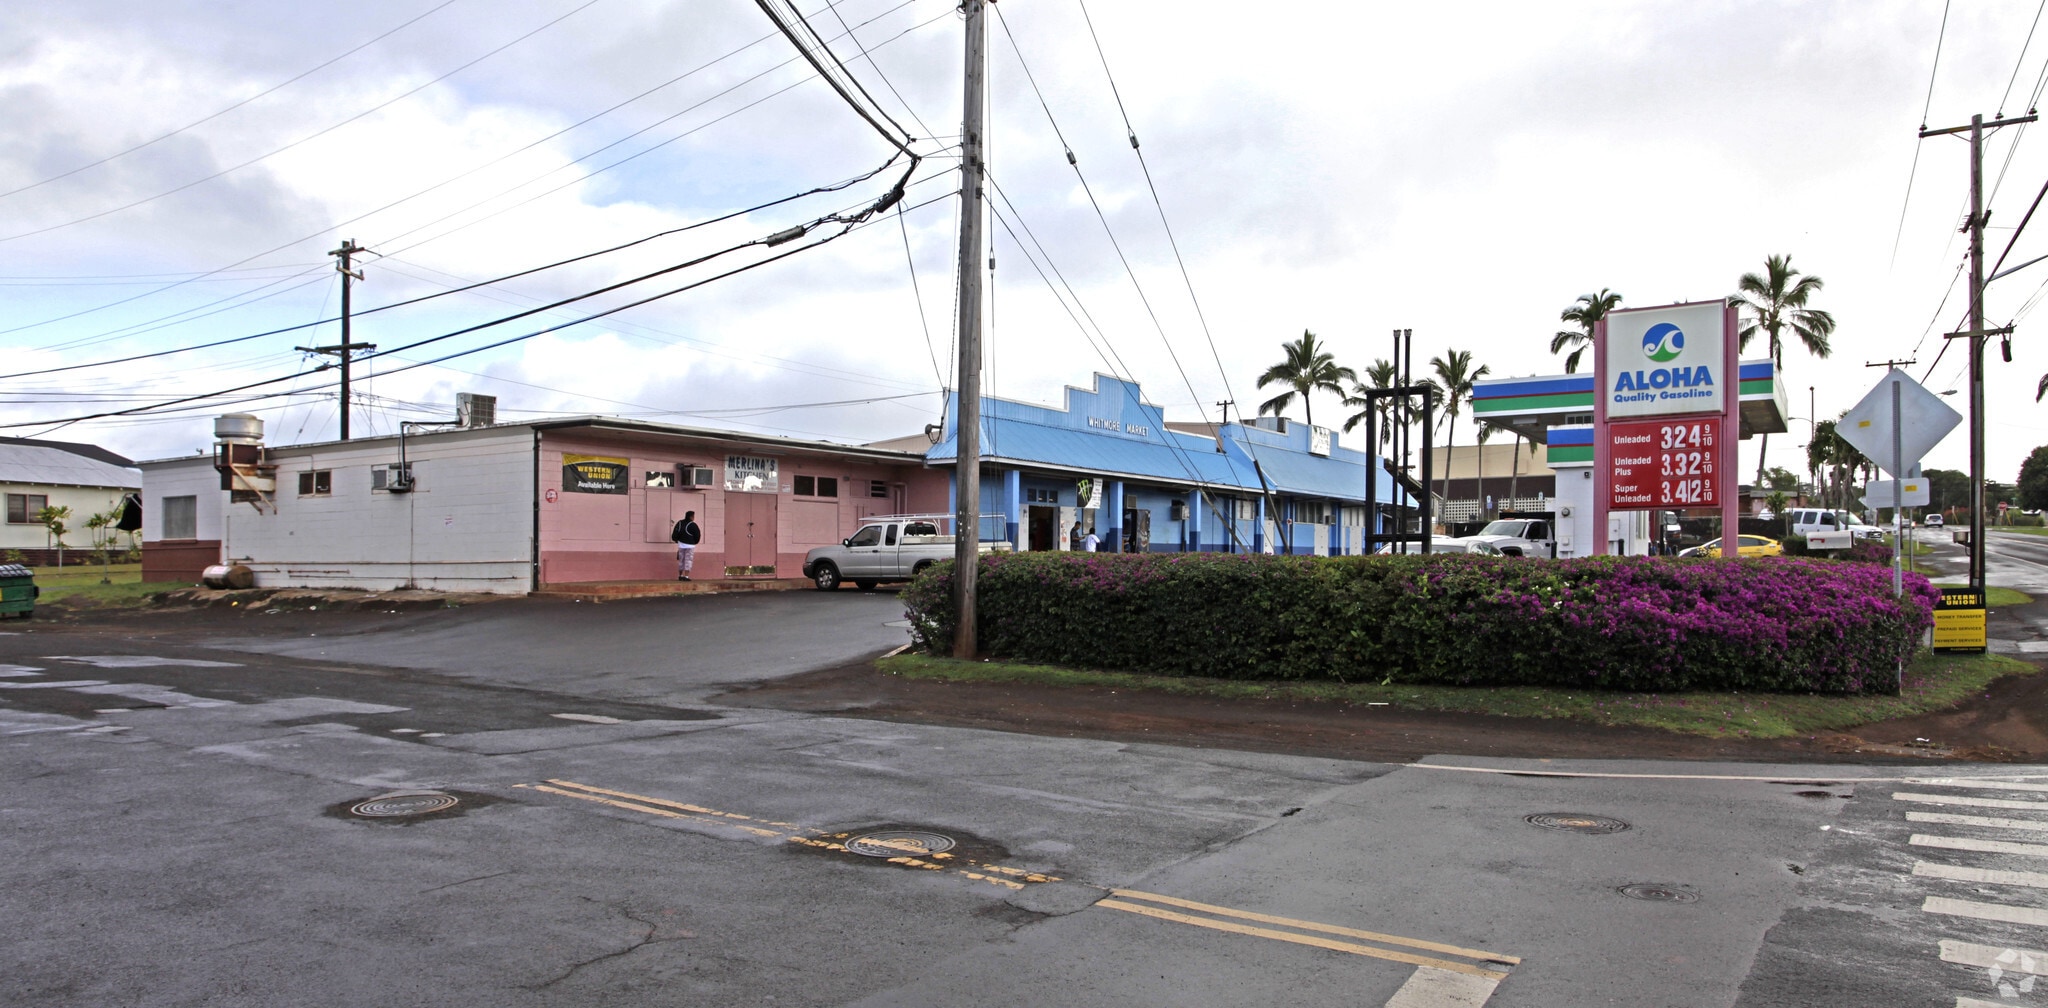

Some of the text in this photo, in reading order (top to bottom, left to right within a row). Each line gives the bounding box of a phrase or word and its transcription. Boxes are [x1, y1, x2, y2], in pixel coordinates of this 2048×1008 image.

[1614, 365, 1714, 391] ALOHA
[1614, 389, 1713, 403] Quality Gasoline
[1087, 416, 1149, 437] WHITMORE MARKET
[1704, 424, 1710, 433] 9
[1614, 425, 1701, 449] Unleaded 324
[1703, 437, 1712, 446] 10
[1704, 452, 1710, 461] 9
[728, 456, 776, 471] MERLINA'S
[1615, 452, 1701, 476] Unleaded 3.32
[577, 465, 612, 474] WESTERN
[1615, 467, 1632, 476] Plus
[1703, 464, 1712, 474] 10
[588, 472, 611, 480] UNION
[577, 481, 602, 489] Available
[1614, 484, 1638, 493] Super
[1704, 480, 1710, 489] 9
[1614, 494, 1651, 503] Unleaded
[1703, 492, 1712, 501] 10
